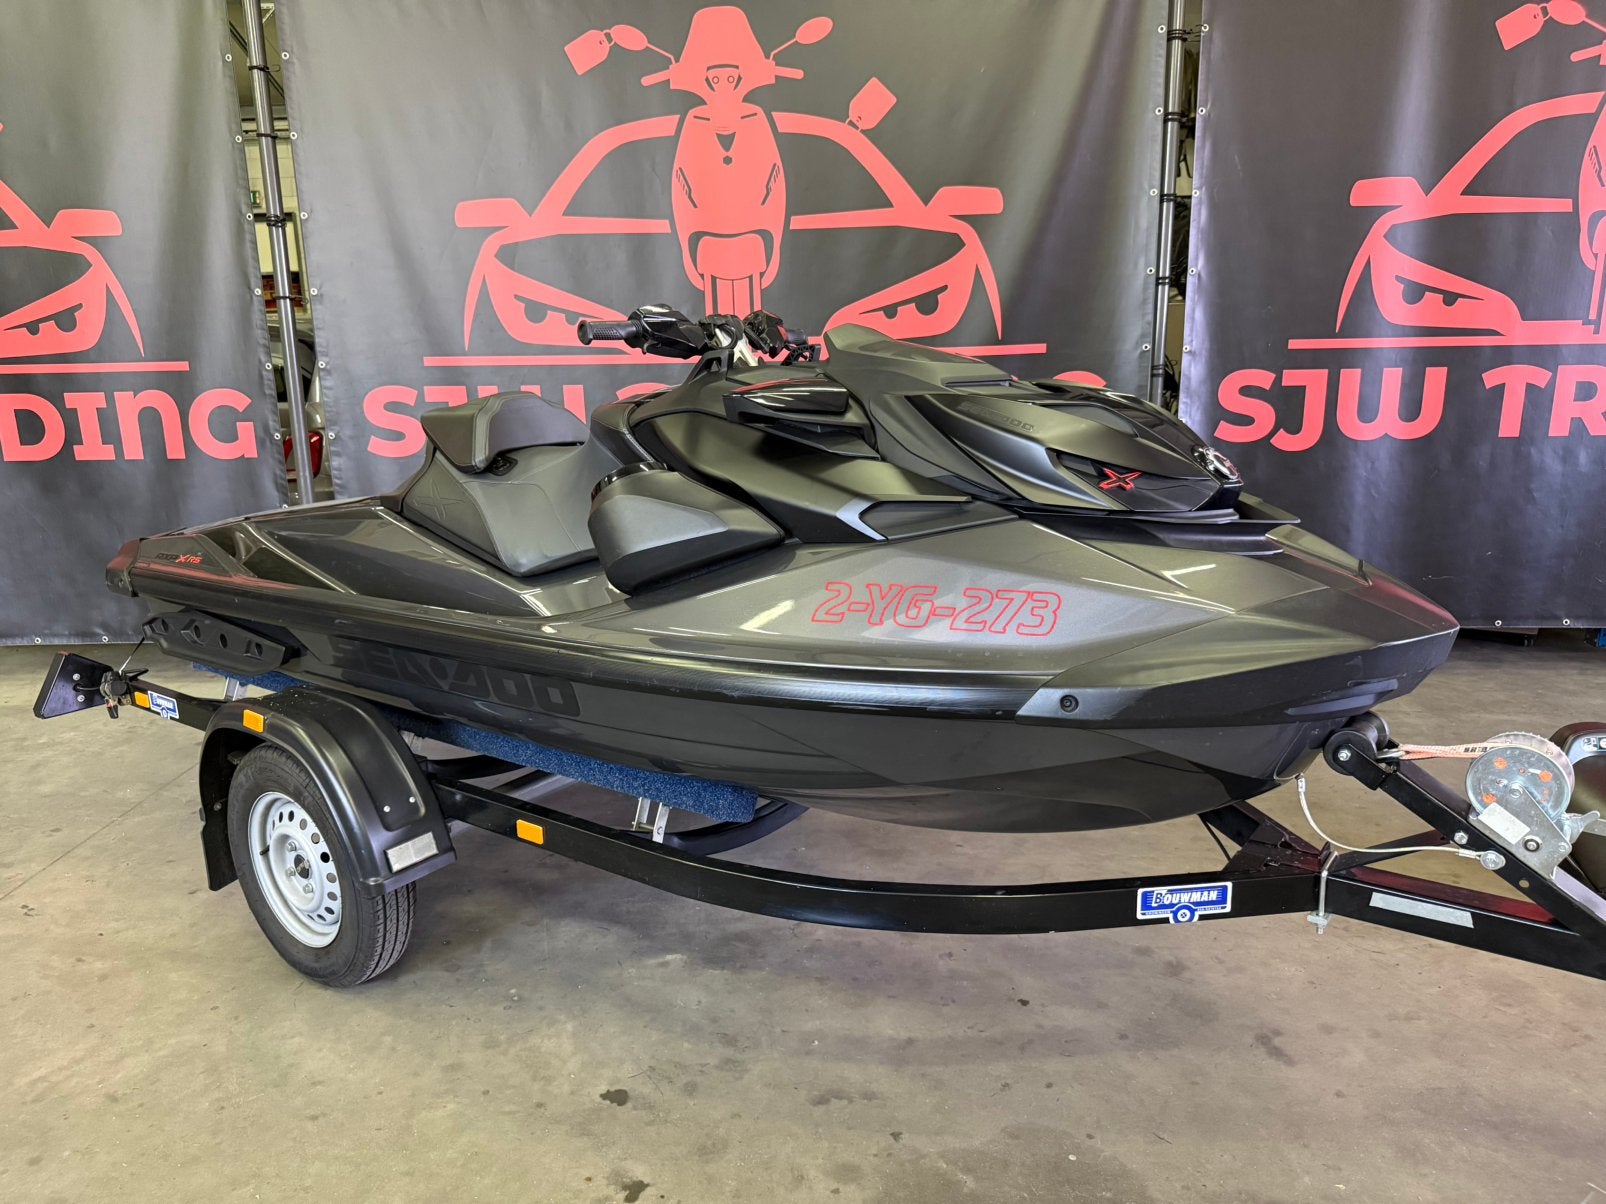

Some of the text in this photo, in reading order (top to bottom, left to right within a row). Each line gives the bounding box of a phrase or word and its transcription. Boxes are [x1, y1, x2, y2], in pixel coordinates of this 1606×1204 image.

[1213, 366, 1448, 452] SJW
[811, 581, 1062, 636] 2-YG-273
[1152, 889, 1218, 907] BOUWMAN
